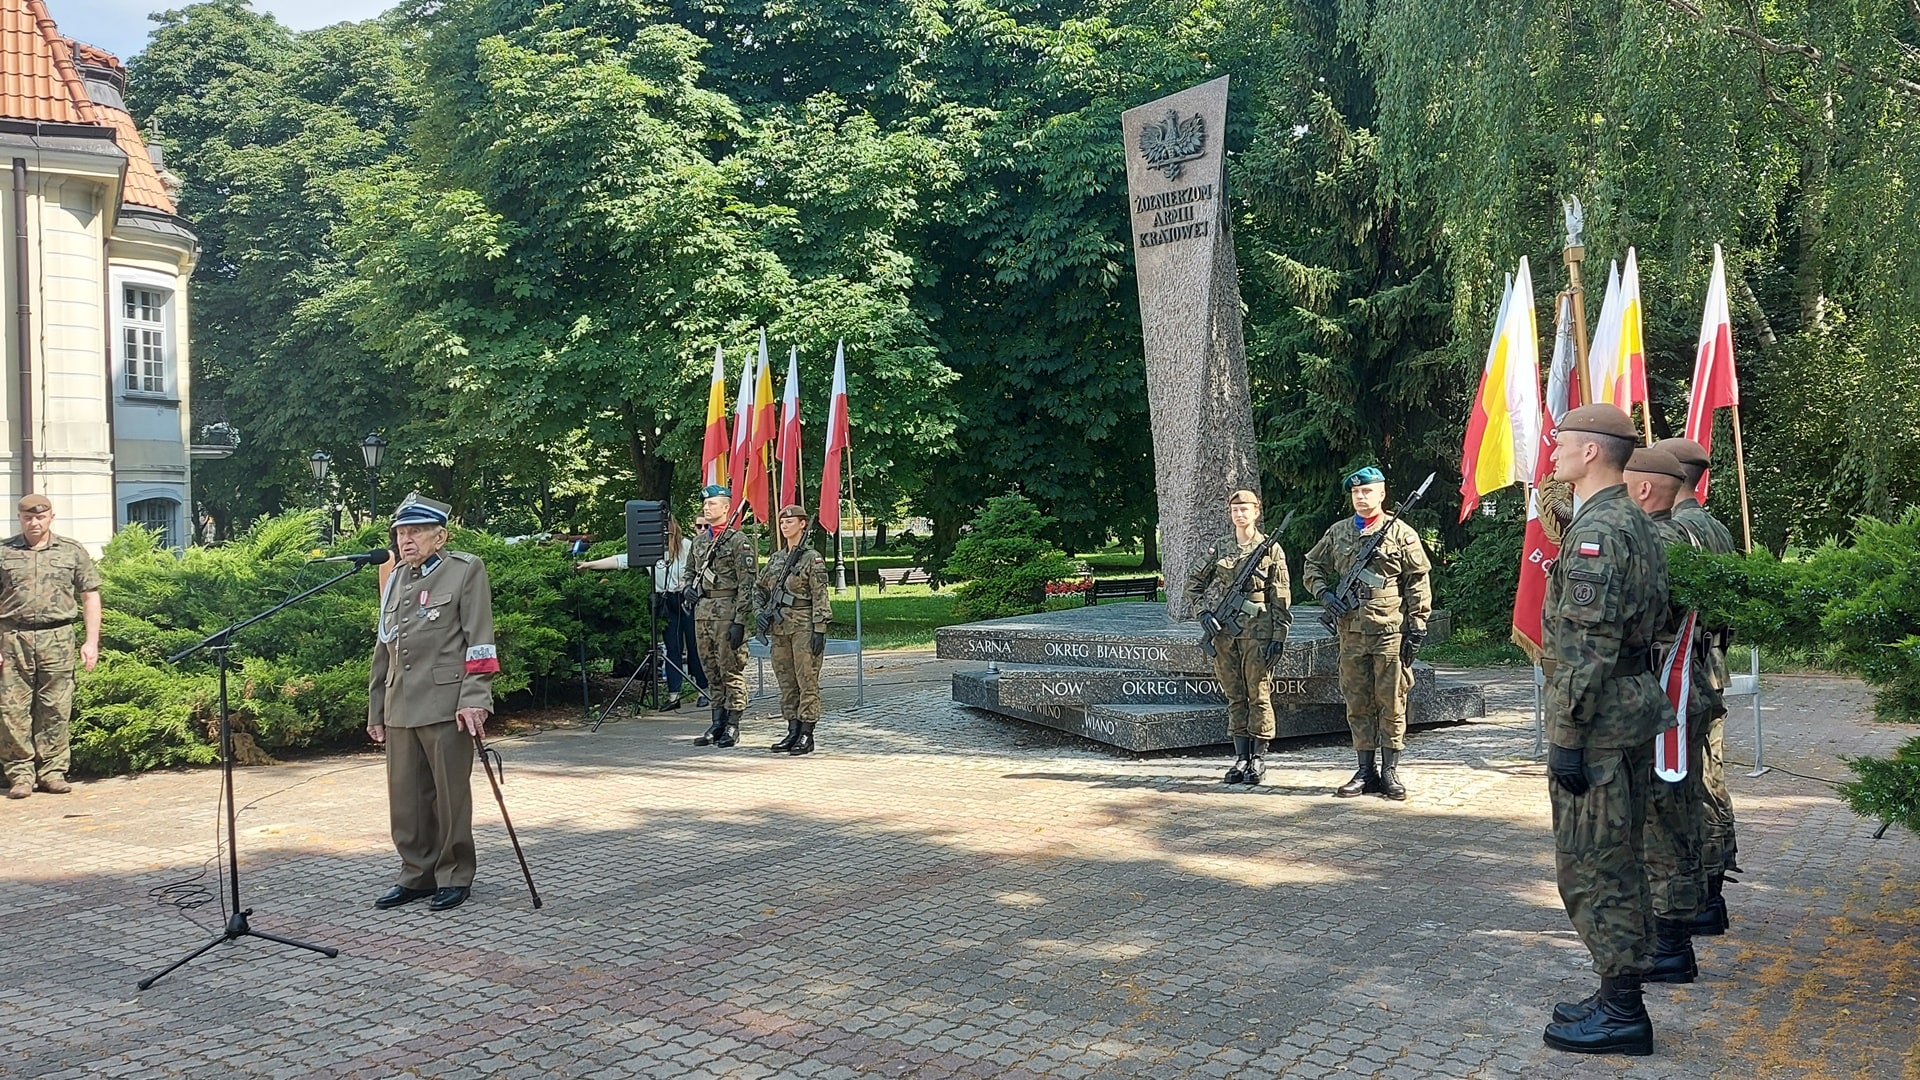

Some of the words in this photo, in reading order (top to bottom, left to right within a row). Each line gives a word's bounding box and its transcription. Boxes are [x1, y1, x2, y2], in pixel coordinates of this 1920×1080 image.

[1134, 184, 1212, 214] ŻOŁNIERZOM
[1152, 206, 1194, 228] ARMII
[1139, 221, 1209, 248] KRAJOWEJ
[1097, 645, 1169, 661] BIAŁYSTOK
